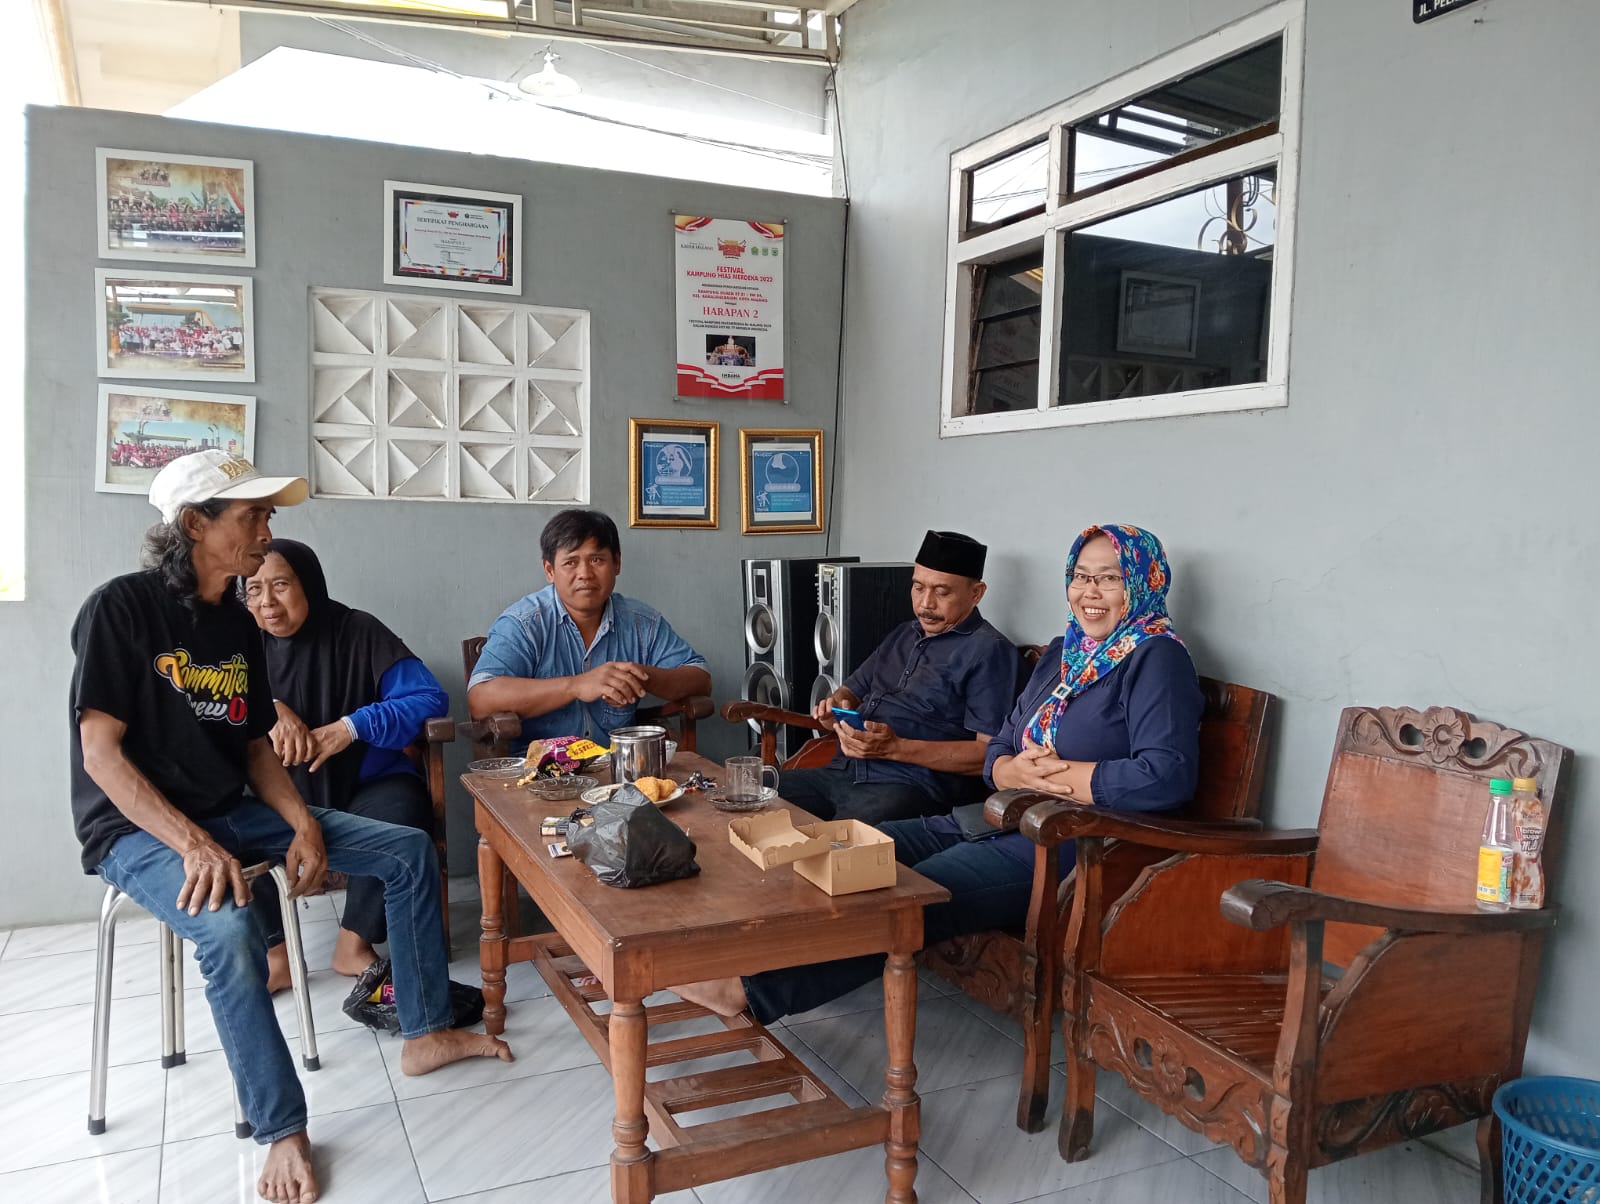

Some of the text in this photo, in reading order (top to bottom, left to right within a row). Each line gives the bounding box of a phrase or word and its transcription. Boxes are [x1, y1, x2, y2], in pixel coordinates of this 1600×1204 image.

[1419, 3, 1431, 16] JL.
[686, 270, 717, 279] KAMPUNG
[717, 265, 745, 274] FESTIVAL
[703, 306, 759, 318] HARAPAN 2
